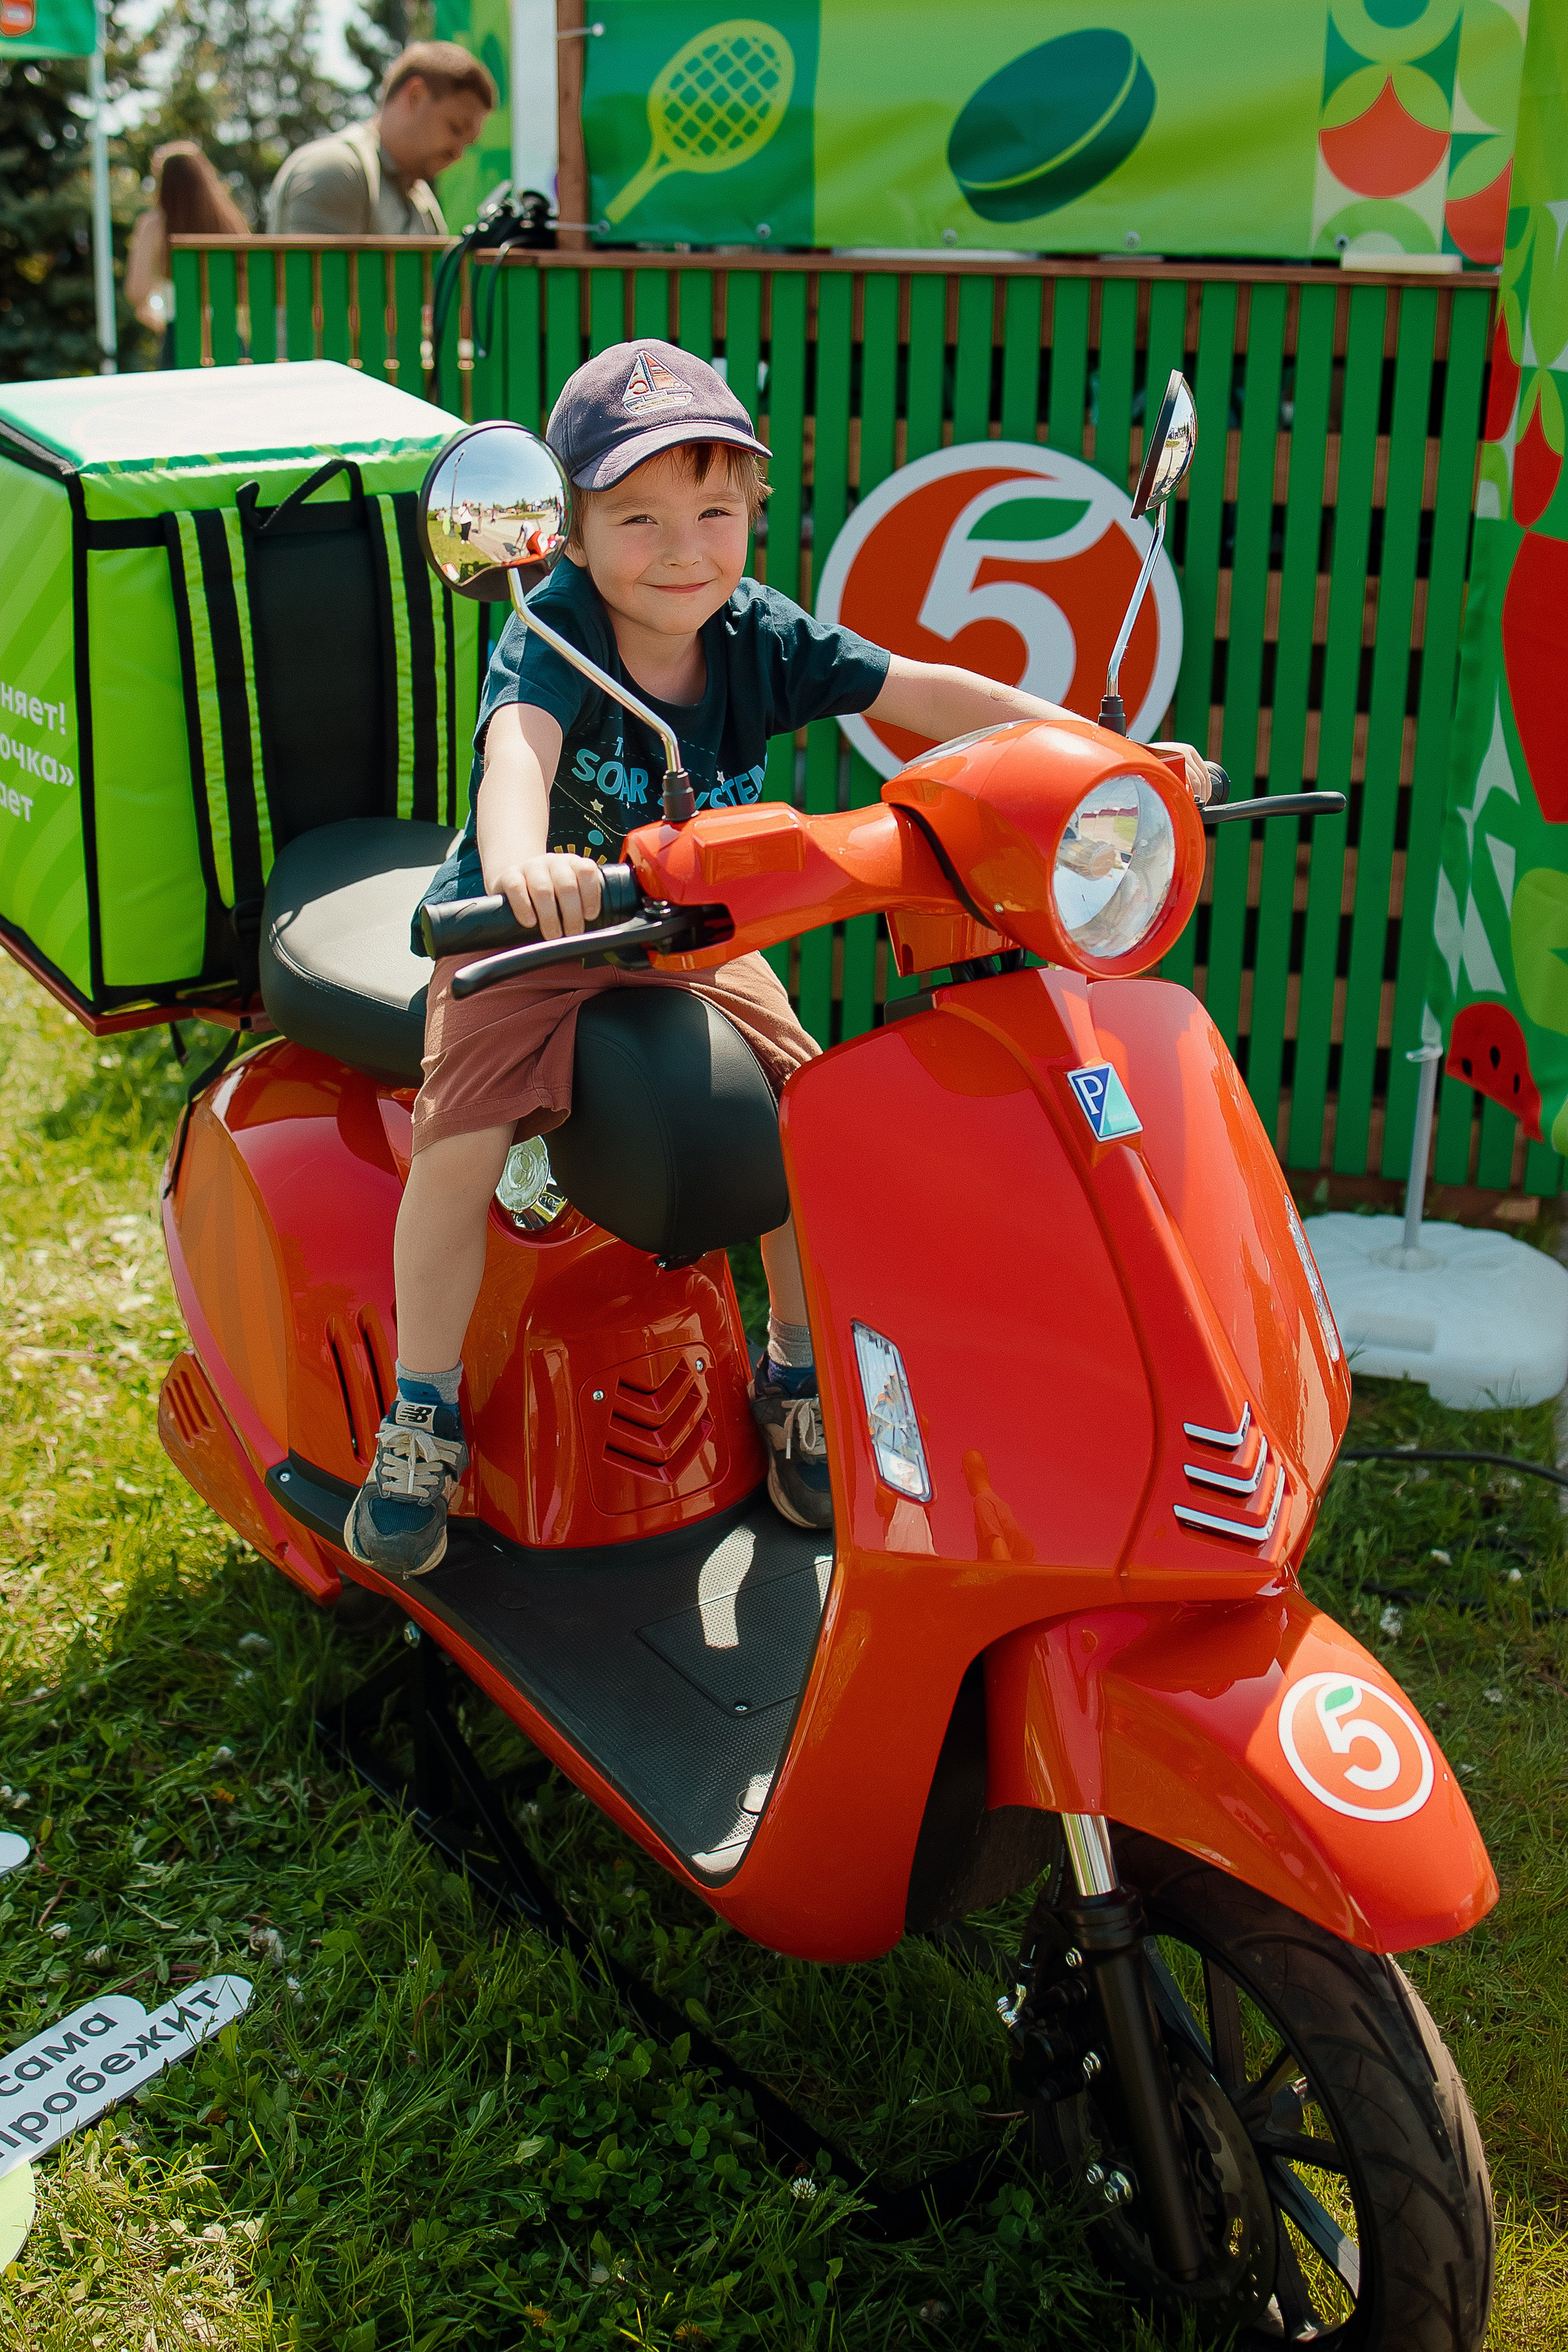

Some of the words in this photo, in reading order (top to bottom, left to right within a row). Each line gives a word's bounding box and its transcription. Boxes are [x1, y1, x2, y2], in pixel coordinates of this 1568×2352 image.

[1076, 1075, 1104, 1115] P
[1314, 1683, 1401, 1791] 5
[0, 2012, 118, 2096] сама
